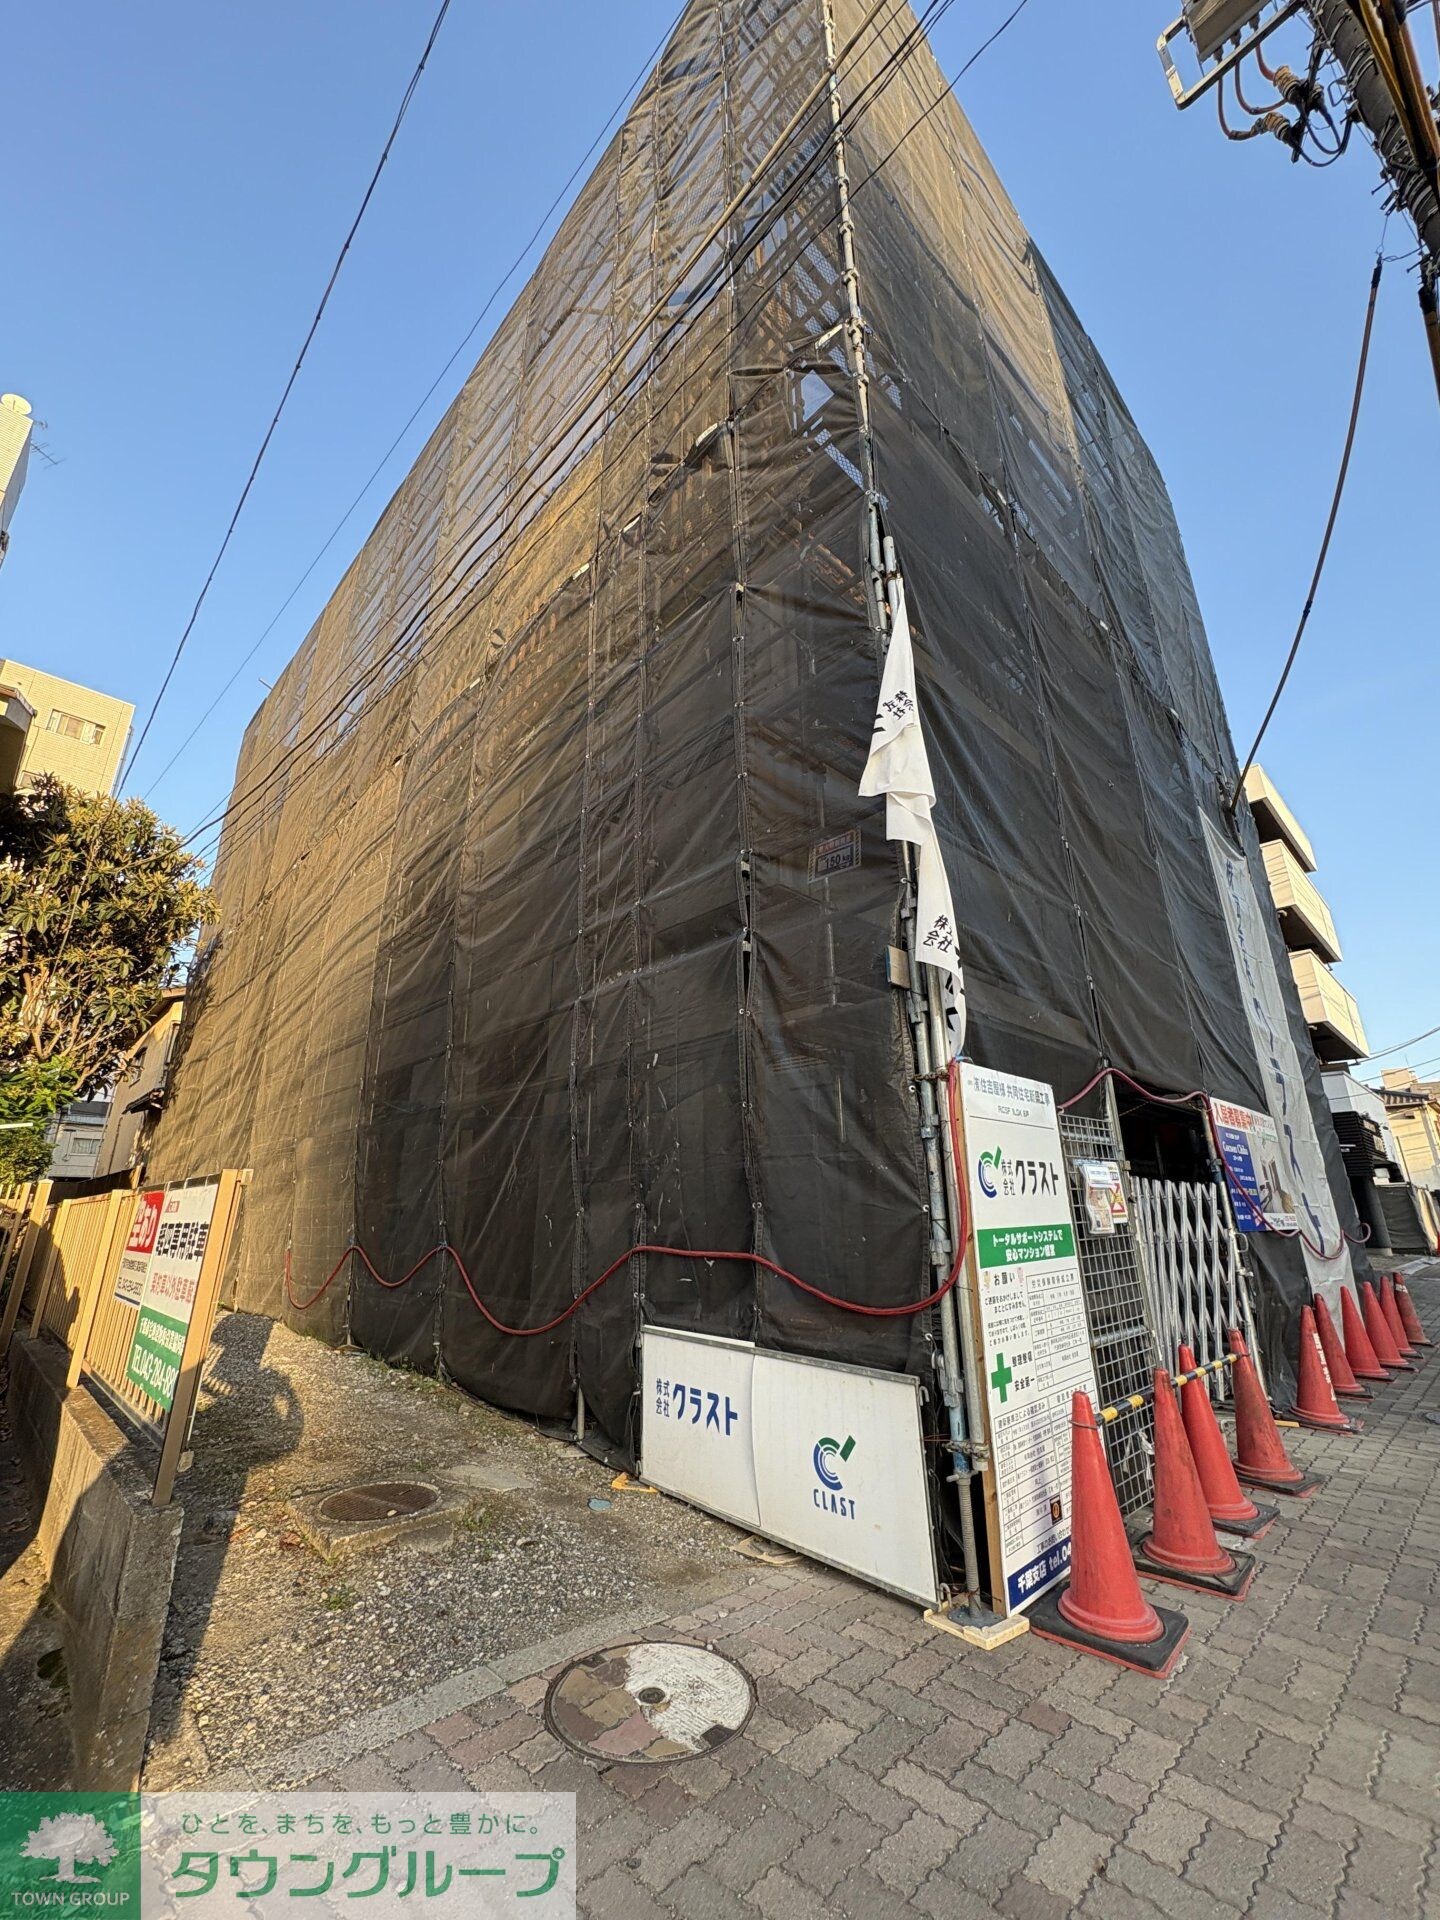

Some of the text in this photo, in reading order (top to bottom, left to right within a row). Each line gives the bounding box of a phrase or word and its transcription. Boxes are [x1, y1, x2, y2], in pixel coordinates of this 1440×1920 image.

[923, 930, 953, 953] 会社
[1015, 1159, 1059, 1196] クラスト
[992, 1229, 1063, 1248] トータルサポートシステムで
[993, 1272, 1016, 1286] お願い
[1014, 1376, 1035, 1392] 安全第一
[672, 1383, 738, 1436] クラスト
[813, 1488, 856, 1520] CLAST
[1017, 1560, 1048, 1594] 千葉支店
